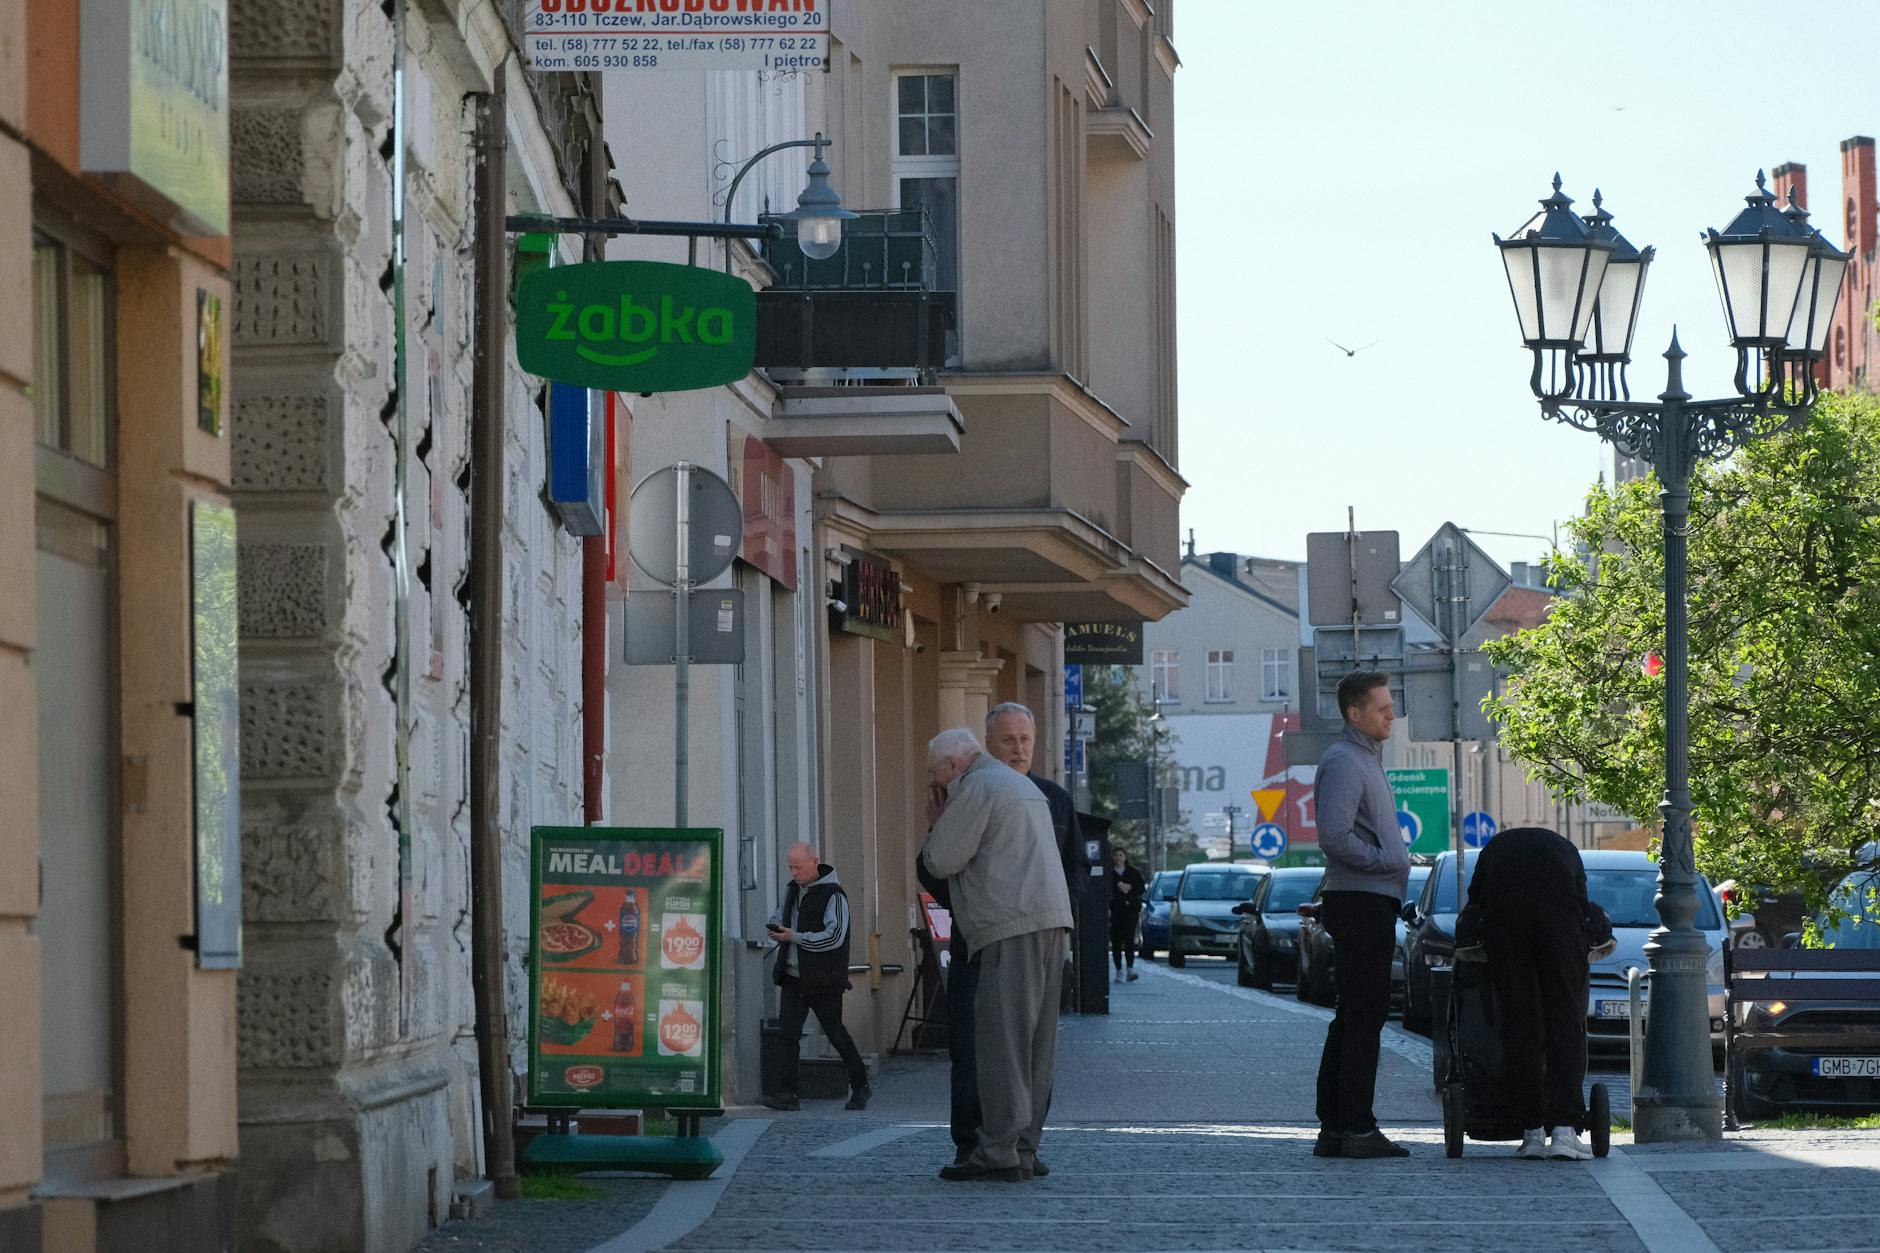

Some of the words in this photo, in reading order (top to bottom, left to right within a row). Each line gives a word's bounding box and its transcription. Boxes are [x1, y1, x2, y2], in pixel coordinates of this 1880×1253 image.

[535, 13, 587, 26] 83-110
[594, 13, 646, 27] Tczew,
[651, 12, 798, 29] Jar.Dąbrowskiego
[803, 12, 821, 25] 20
[535, 39, 557, 50] tel.
[562, 38, 588, 53] (58)
[592, 39, 617, 50] 777
[622, 39, 638, 50] 52
[642, 39, 663, 52] 22,
[667, 38, 714, 50] tel./fax
[719, 38, 745, 52] (58)
[750, 38, 774, 49] 777
[779, 38, 795, 49] 62
[800, 38, 816, 49] 22
[535, 56, 570, 67] kom.
[574, 55, 599, 67] 605
[604, 55, 628, 67] 930
[633, 55, 657, 67] 858
[774, 55, 821, 70] piętro
[545, 290, 734, 344] żabka
[1087, 843, 1098, 857] P
[549, 852, 622, 874] MEAL
[1603, 1003, 1625, 1014] GTC
[1823, 1060, 1850, 1074] GMB
